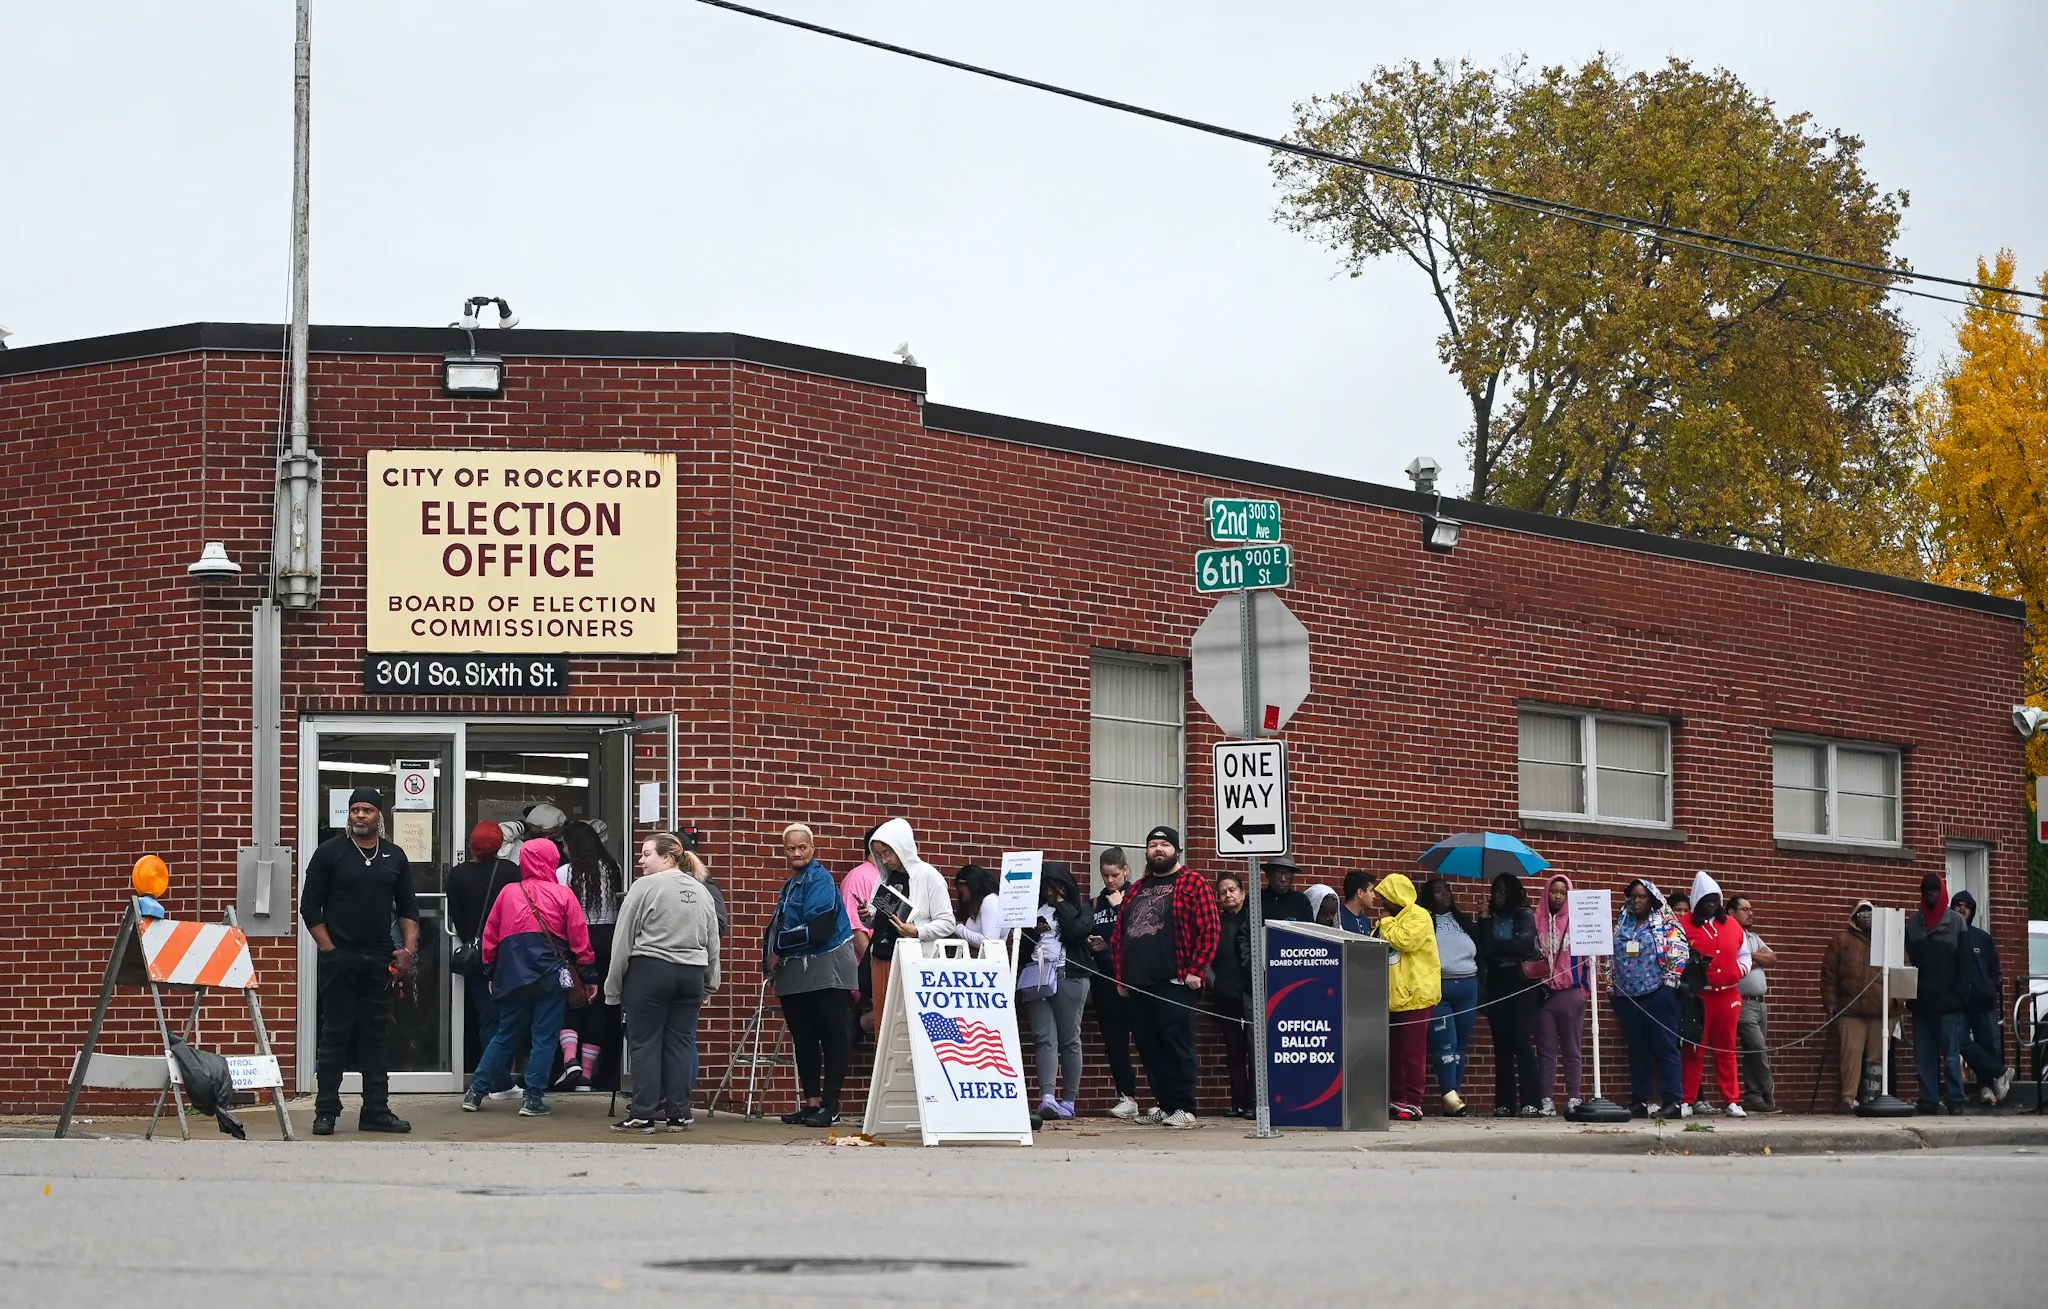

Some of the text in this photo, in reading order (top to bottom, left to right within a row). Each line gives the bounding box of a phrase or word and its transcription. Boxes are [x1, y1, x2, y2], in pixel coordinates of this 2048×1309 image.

[382, 468, 661, 488] CITY OF ROCKFORD
[422, 501, 620, 536] ELECTION
[1216, 504, 1276, 536] 2nd 300 S
[1256, 523, 1270, 539] Ave
[442, 542, 594, 578] OFFICE
[1202, 548, 1281, 586] 6th 900 E
[1258, 569, 1271, 584] St
[388, 595, 656, 613] BOARD OF ELECTION
[410, 618, 634, 637] COMMISSIONERS
[376, 660, 558, 687] 301 So. Sixth St.
[1224, 752, 1273, 778] ONE
[1224, 783, 1274, 809] WAY
[1280, 948, 1328, 958] ROCKFORD
[920, 971, 998, 988] EARLY
[915, 992, 1008, 1009] VOTING
[1278, 1020, 1331, 1032] OFFICIAL
[1282, 1036, 1327, 1048] BALLOT
[1274, 1052, 1335, 1064] DROP BOX
[958, 1082, 1018, 1098] HERE
